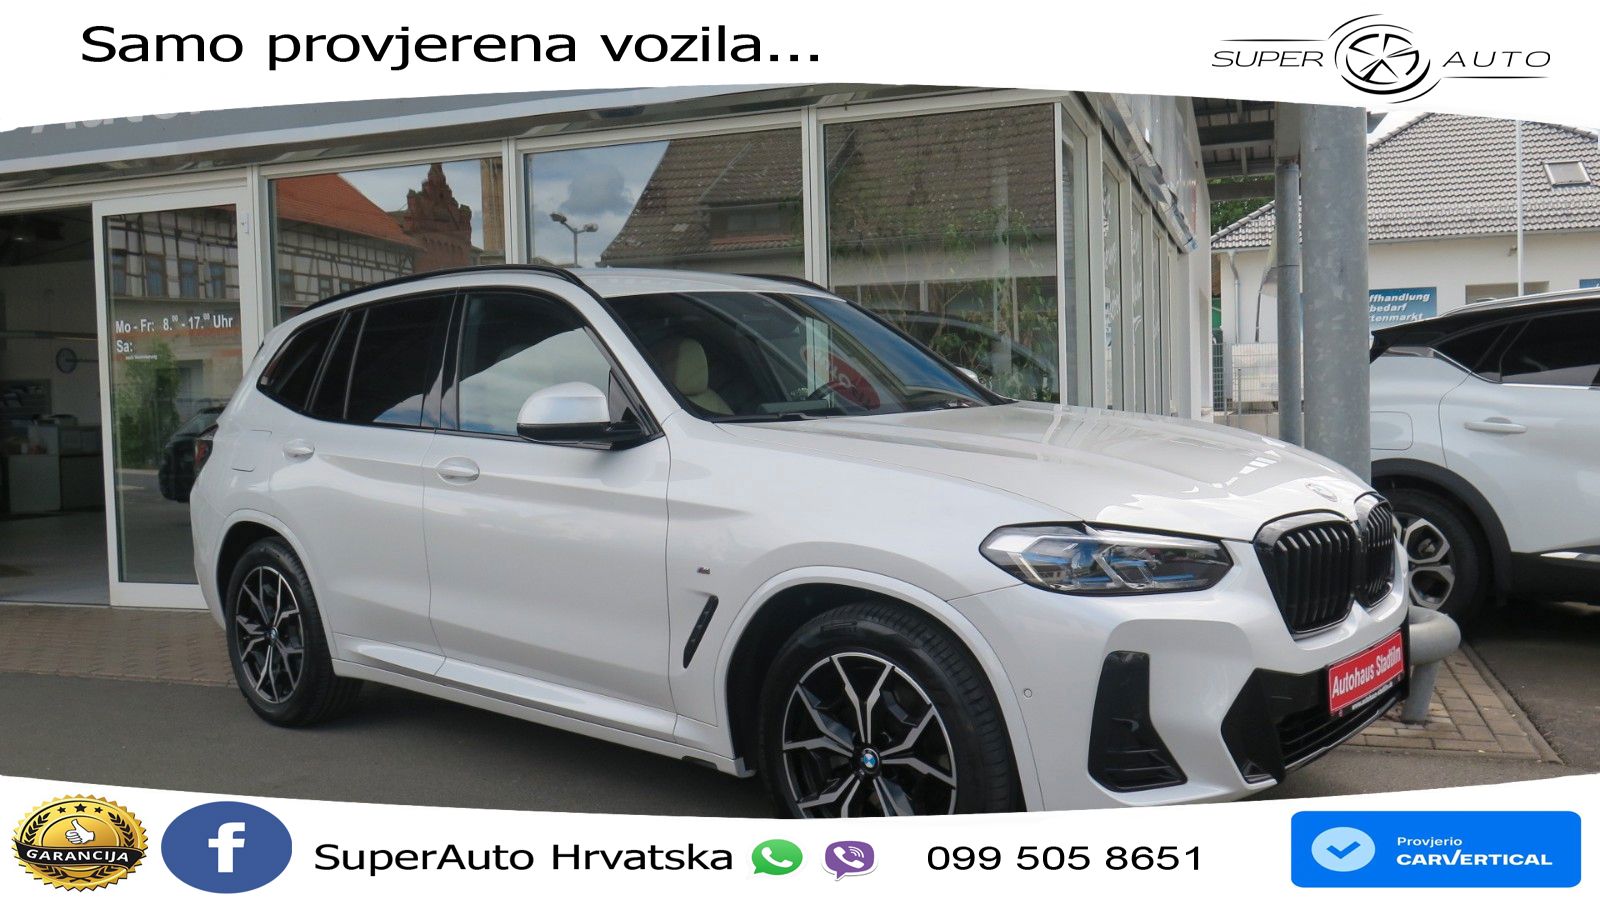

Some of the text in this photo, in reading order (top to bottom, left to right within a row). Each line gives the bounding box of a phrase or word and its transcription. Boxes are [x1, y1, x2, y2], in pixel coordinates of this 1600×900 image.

[115, 320, 131, 334] Mo
[140, 319, 155, 333] Fr:
[213, 315, 233, 329] Uhr
[116, 339, 133, 353] Sa:
[1332, 664, 1375, 698] Autohaus
